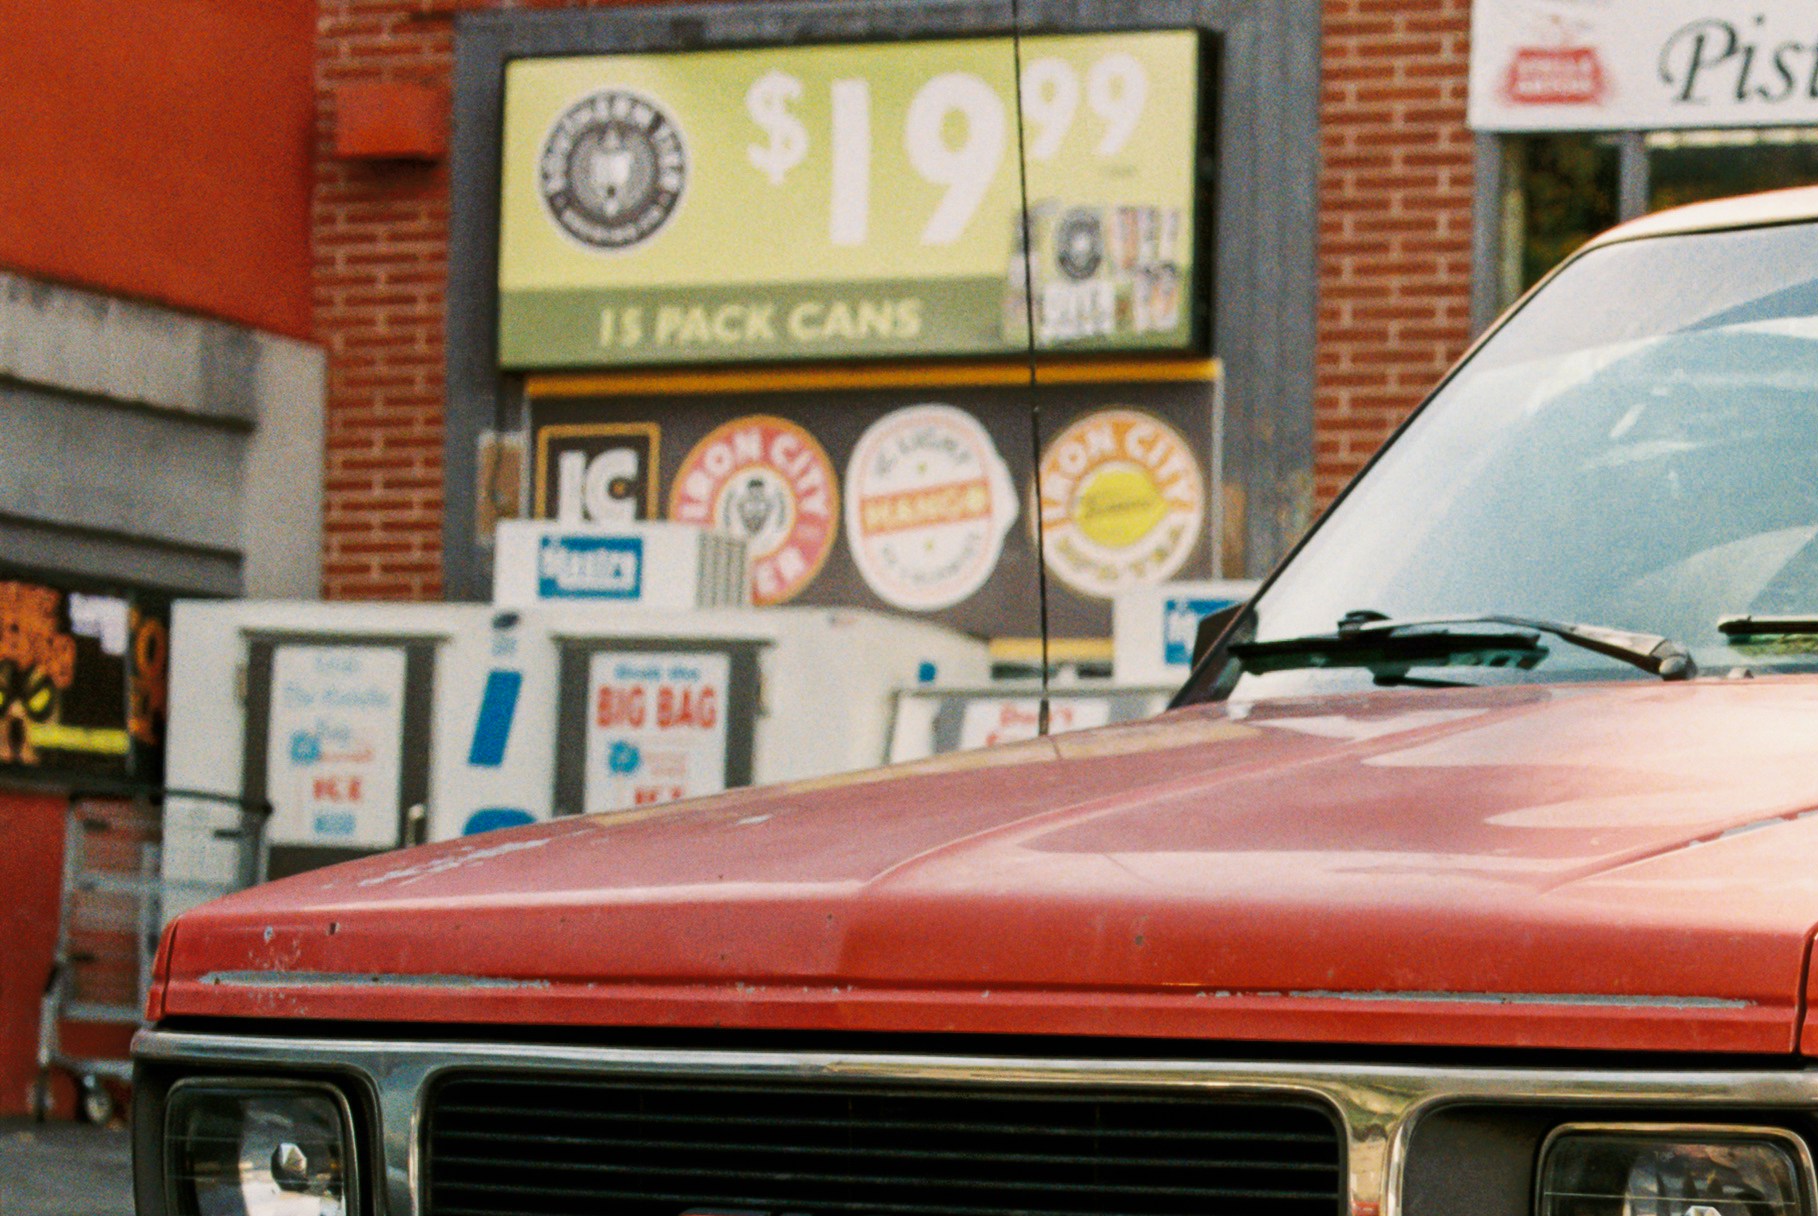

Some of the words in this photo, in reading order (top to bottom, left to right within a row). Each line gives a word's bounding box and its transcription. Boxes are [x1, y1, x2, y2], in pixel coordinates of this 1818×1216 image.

[599, 305, 639, 349] 15
[655, 302, 776, 346] PACK
[787, 298, 922, 342] CANS
[558, 448, 639, 524] IC
[679, 428, 763, 520] IRON
[769, 432, 830, 518] CITY
[1041, 427, 1115, 520] IRON
[1125, 423, 1194, 506] CITY
[597, 684, 646, 729] BIG
[656, 684, 717, 730] BAG
